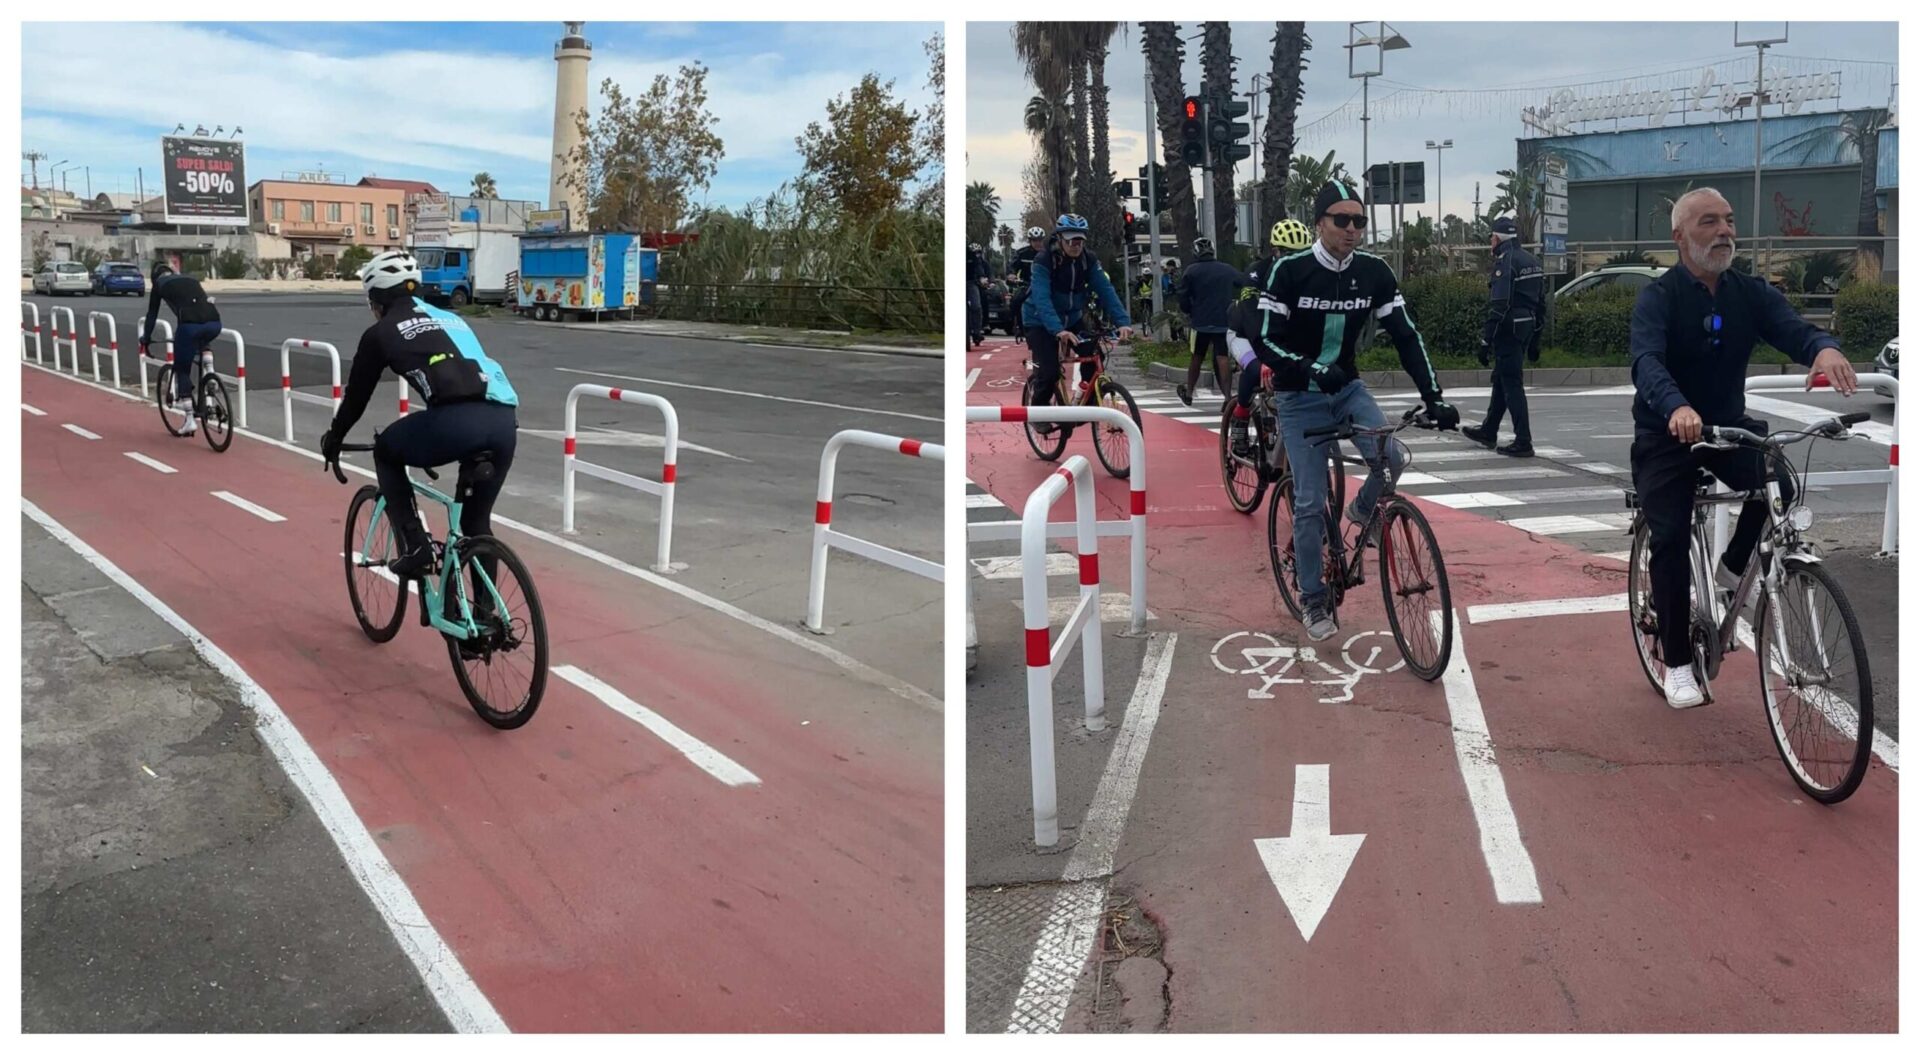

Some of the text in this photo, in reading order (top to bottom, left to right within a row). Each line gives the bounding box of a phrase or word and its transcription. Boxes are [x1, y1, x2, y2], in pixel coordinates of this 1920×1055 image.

[176, 158, 233, 172] SUPER SALDI
[178, 171, 235, 194] -50%
[1297, 296, 1373, 310] Bianchi
